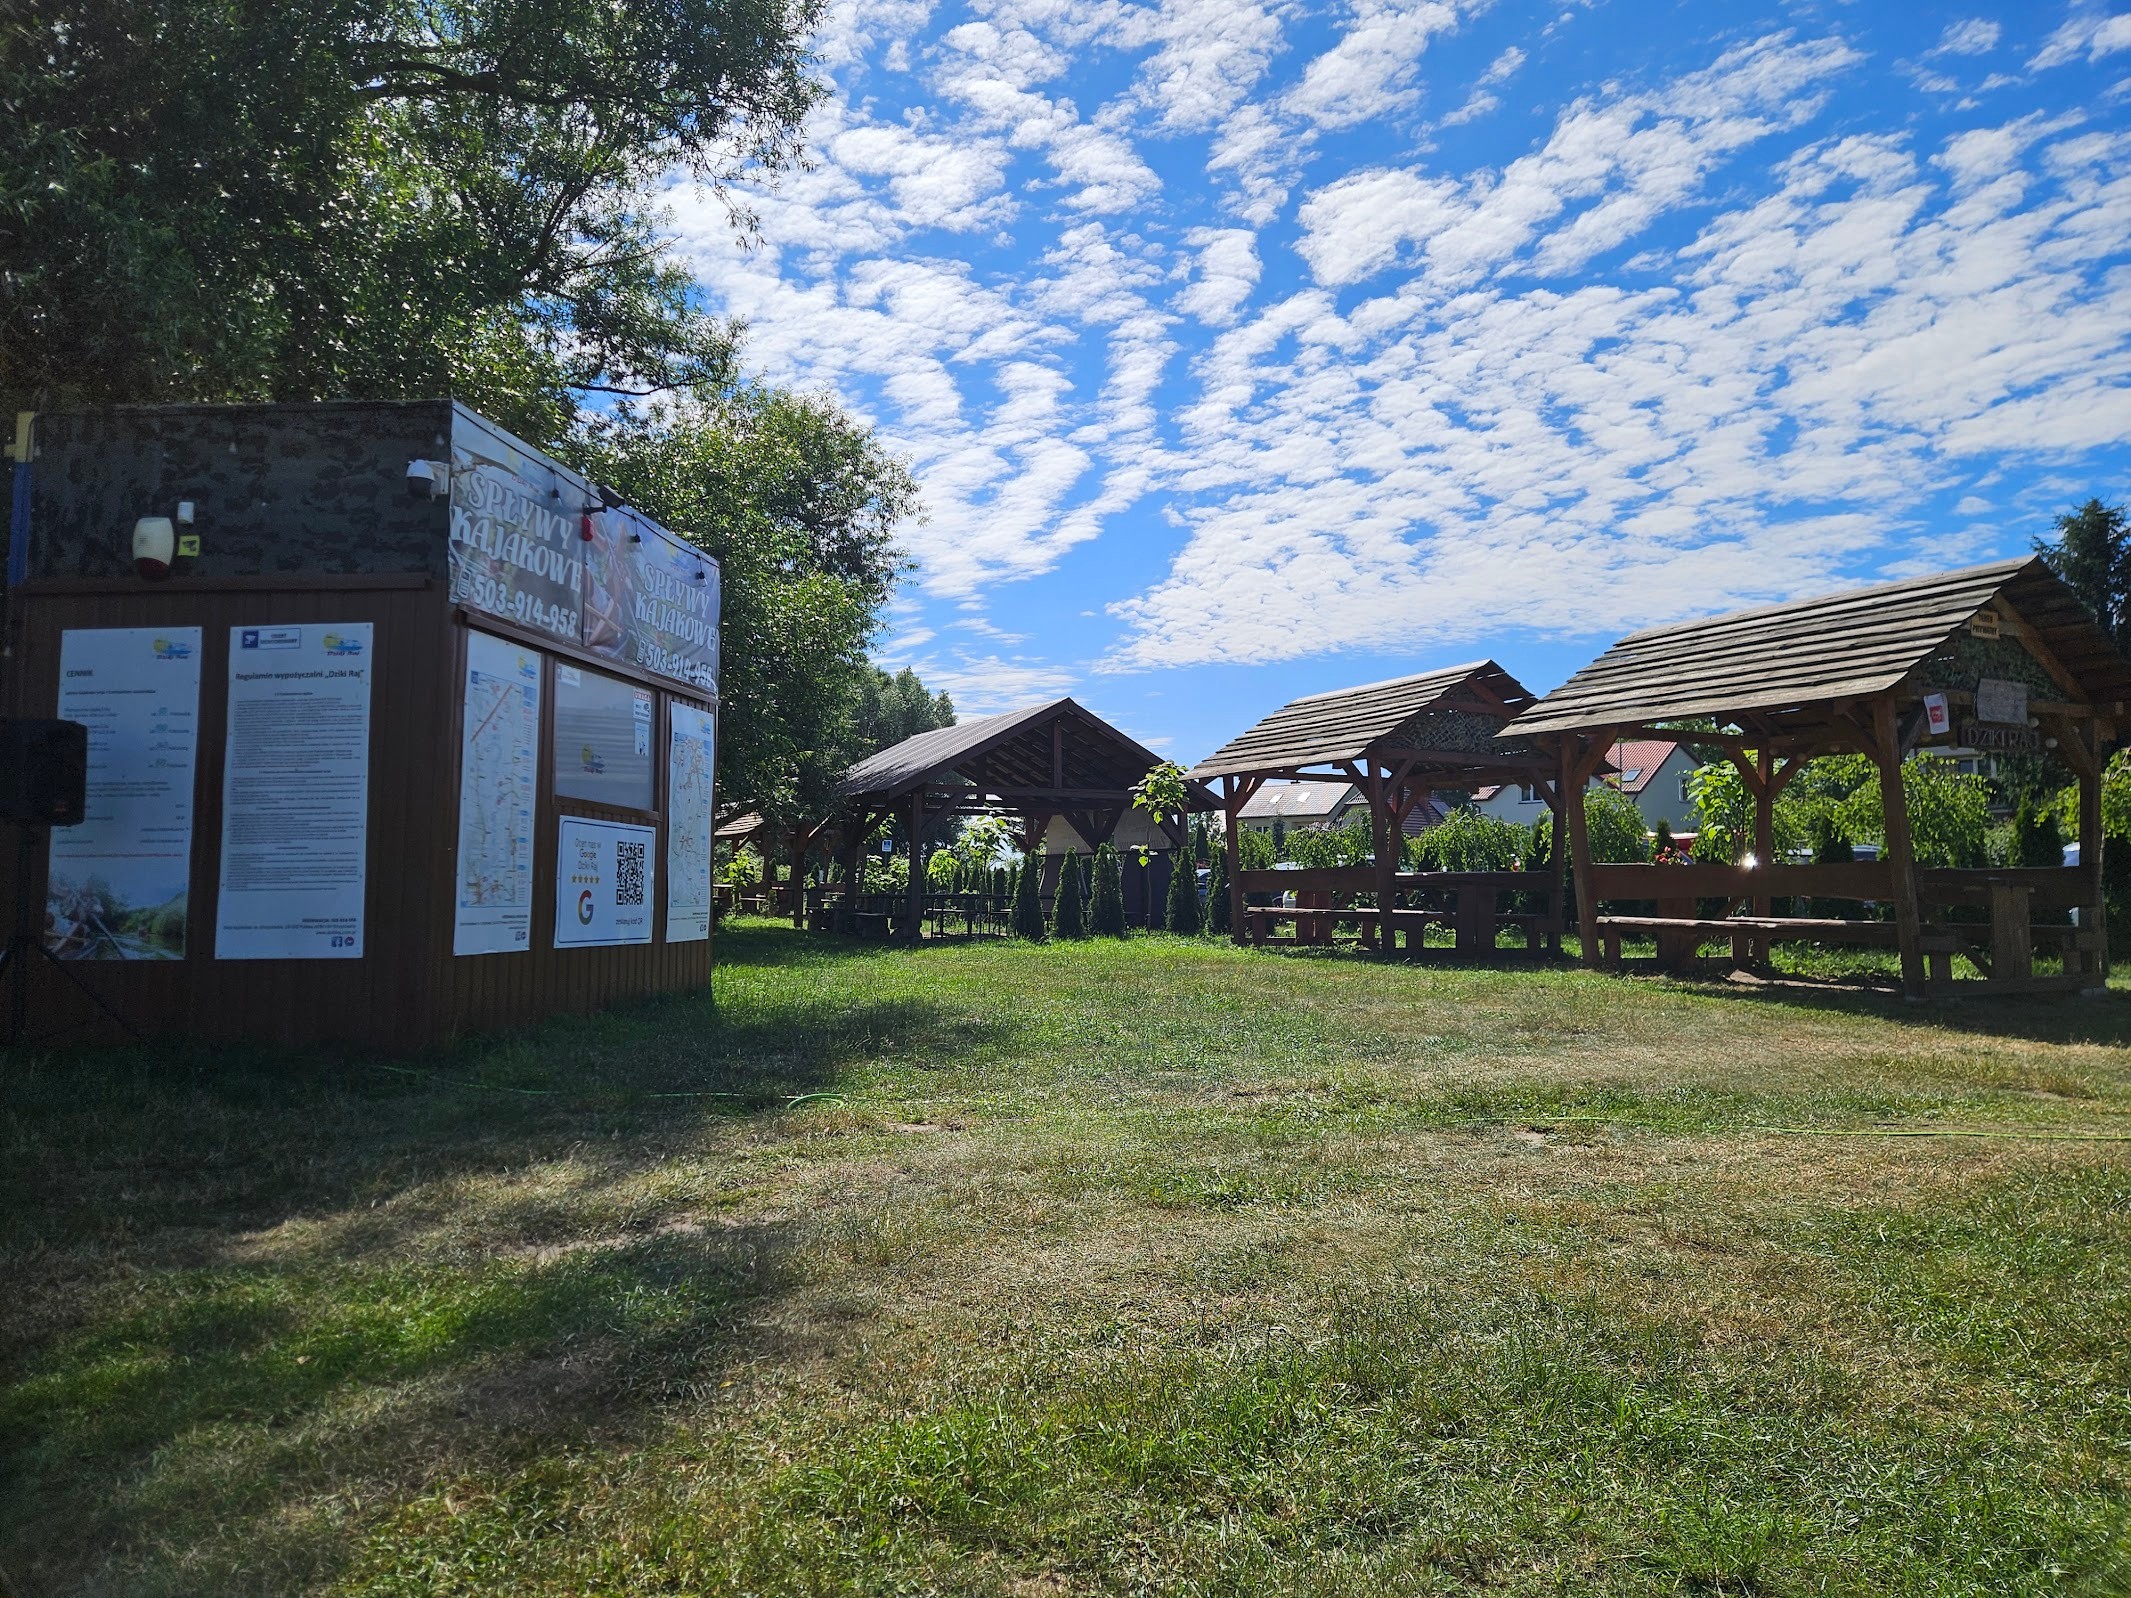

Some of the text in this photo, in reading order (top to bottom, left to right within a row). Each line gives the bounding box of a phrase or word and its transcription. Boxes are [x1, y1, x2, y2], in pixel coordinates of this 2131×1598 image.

[468, 471, 573, 549] SPŁYWY
[451, 505, 583, 592] KAJAKOWE
[473, 574, 578, 637] 503-914-958
[644, 564, 709, 618] SPŁYWY
[635, 592, 717, 652] KAJAKOWE
[235, 671, 273, 681] Regulamin
[274, 669, 323, 680] wypożyczalni
[1967, 727, 2006, 747] DZIKI
[579, 848, 597, 860] Google
